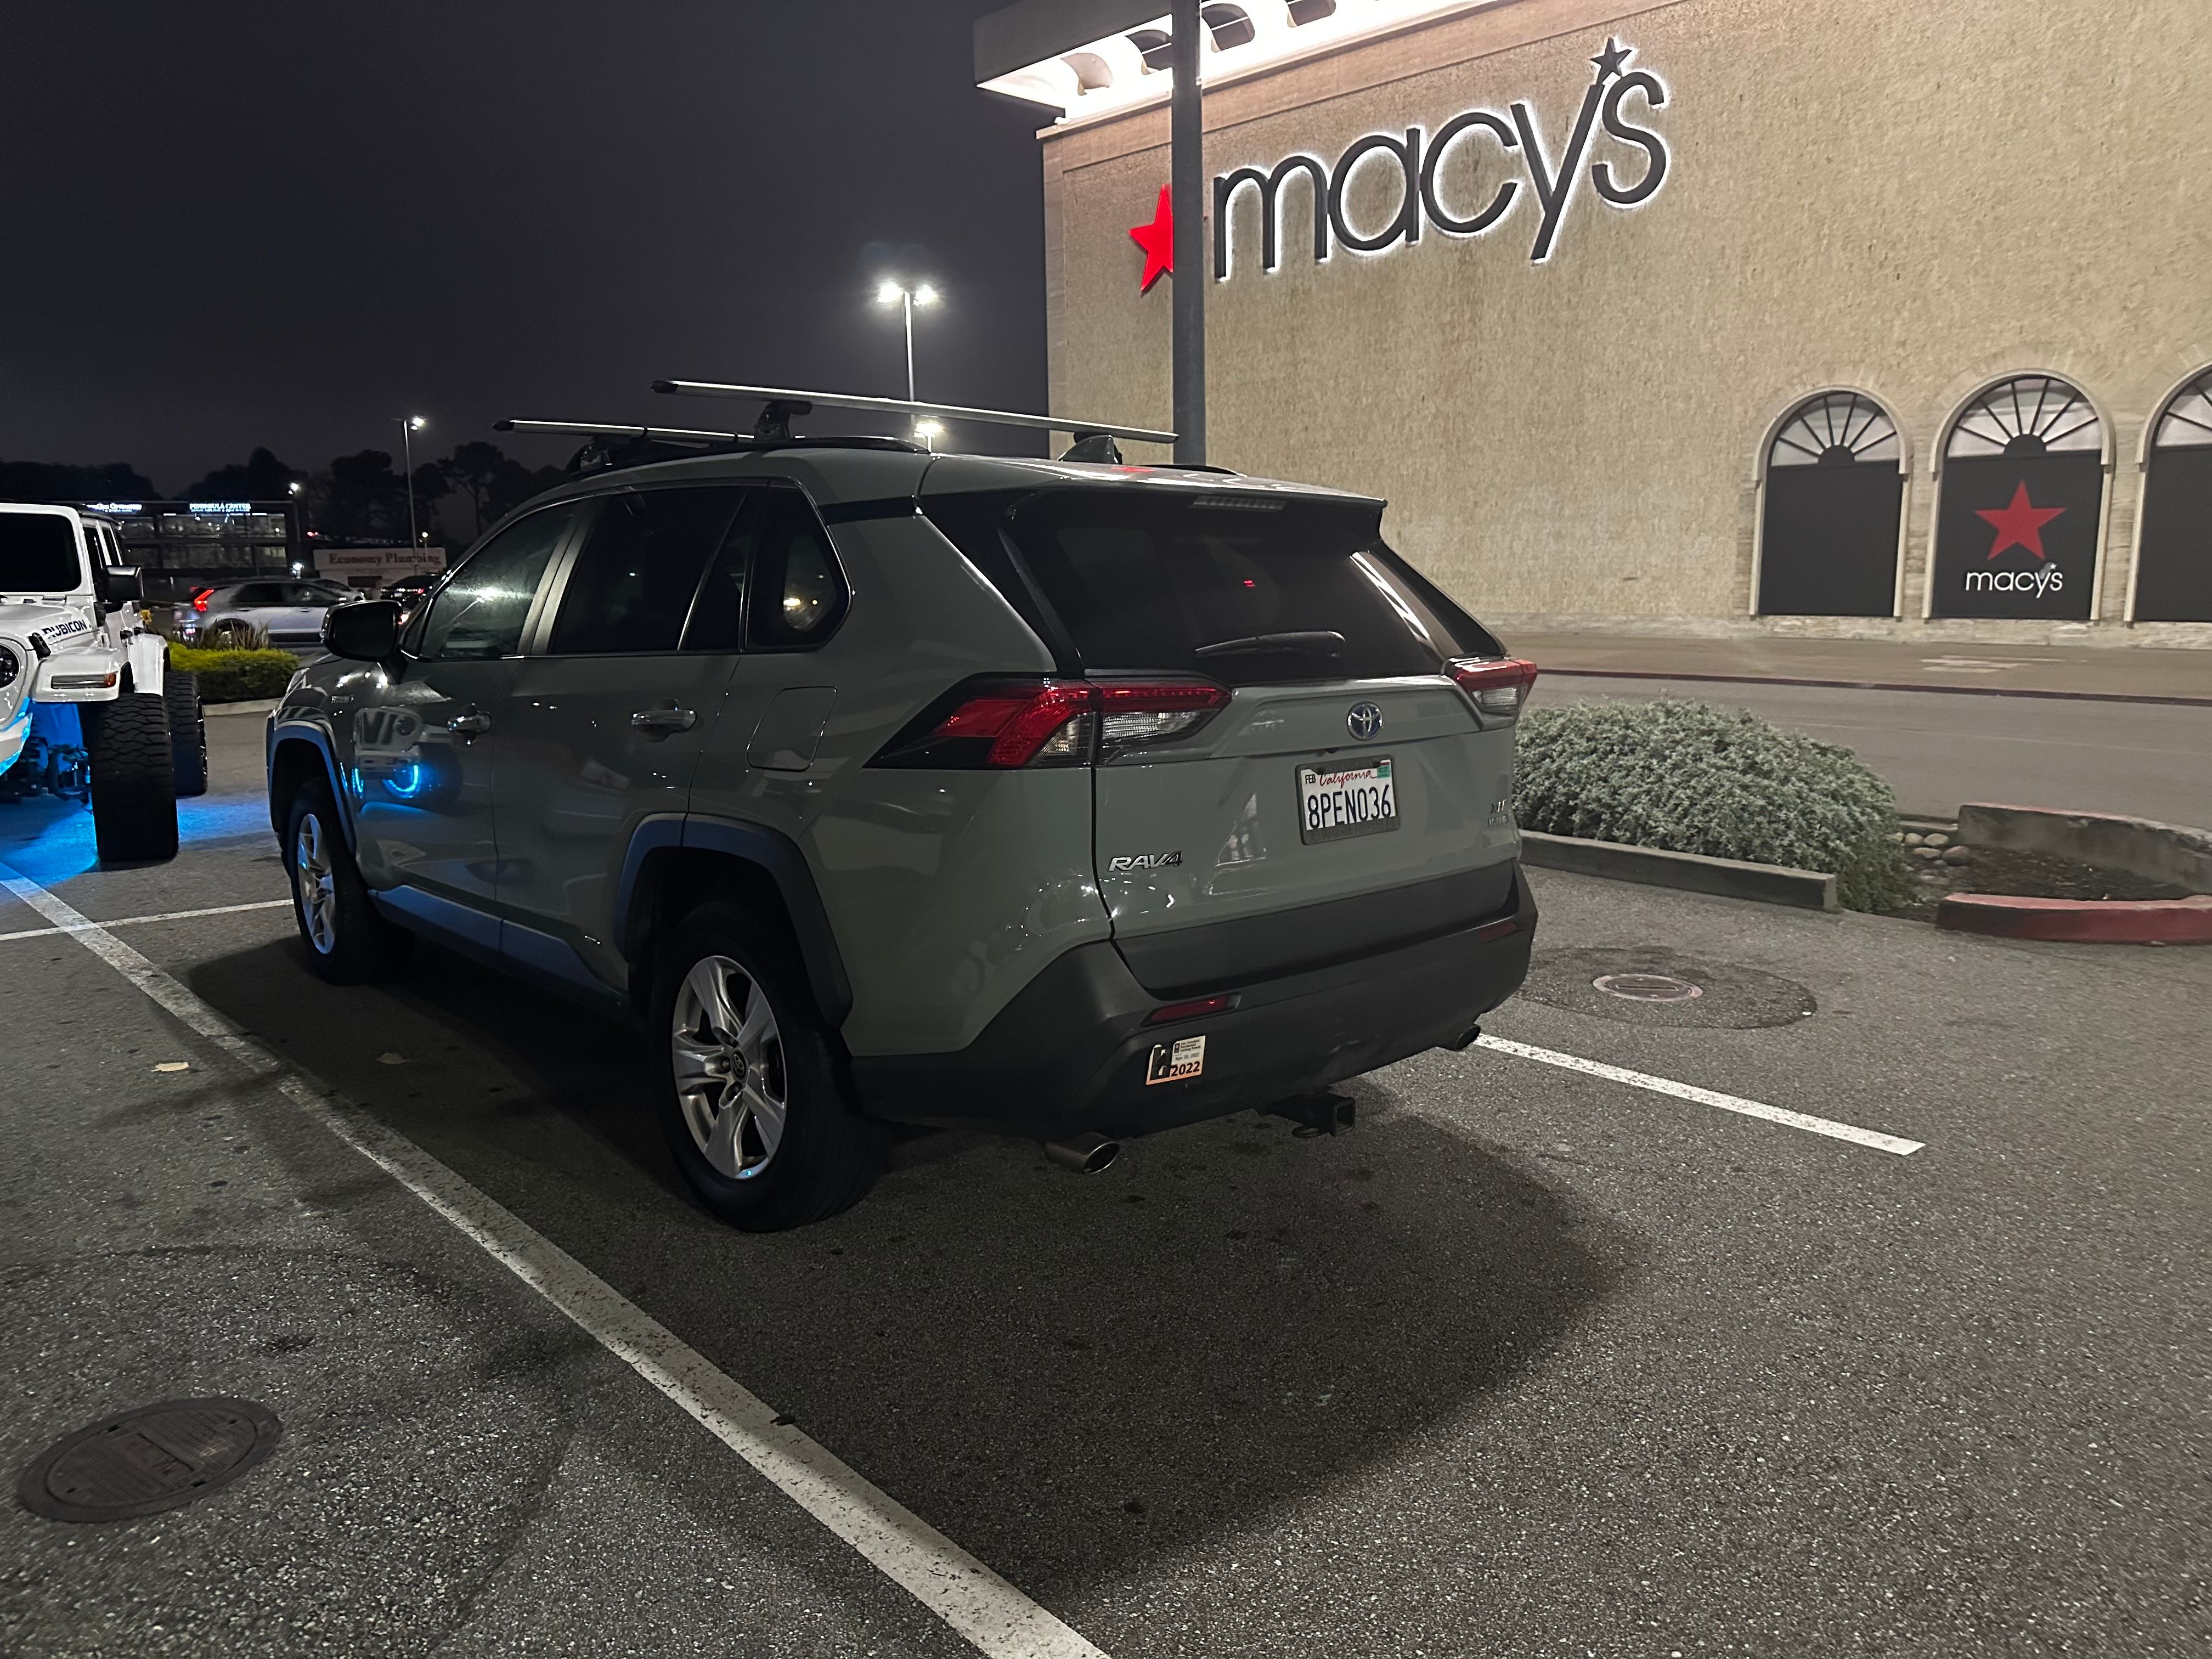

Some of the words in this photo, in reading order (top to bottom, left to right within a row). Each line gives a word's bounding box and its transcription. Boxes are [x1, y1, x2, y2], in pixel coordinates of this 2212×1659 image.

[329, 554, 382, 566] Economy
[42, 619, 88, 639] RUBICON
[1305, 774, 1316, 785] FEB
[1319, 770, 1378, 789] California
[1307, 785, 1391, 829] 8PEN036
[1108, 850, 1183, 872] RAV4
[1171, 1060, 1200, 1077] 2022
